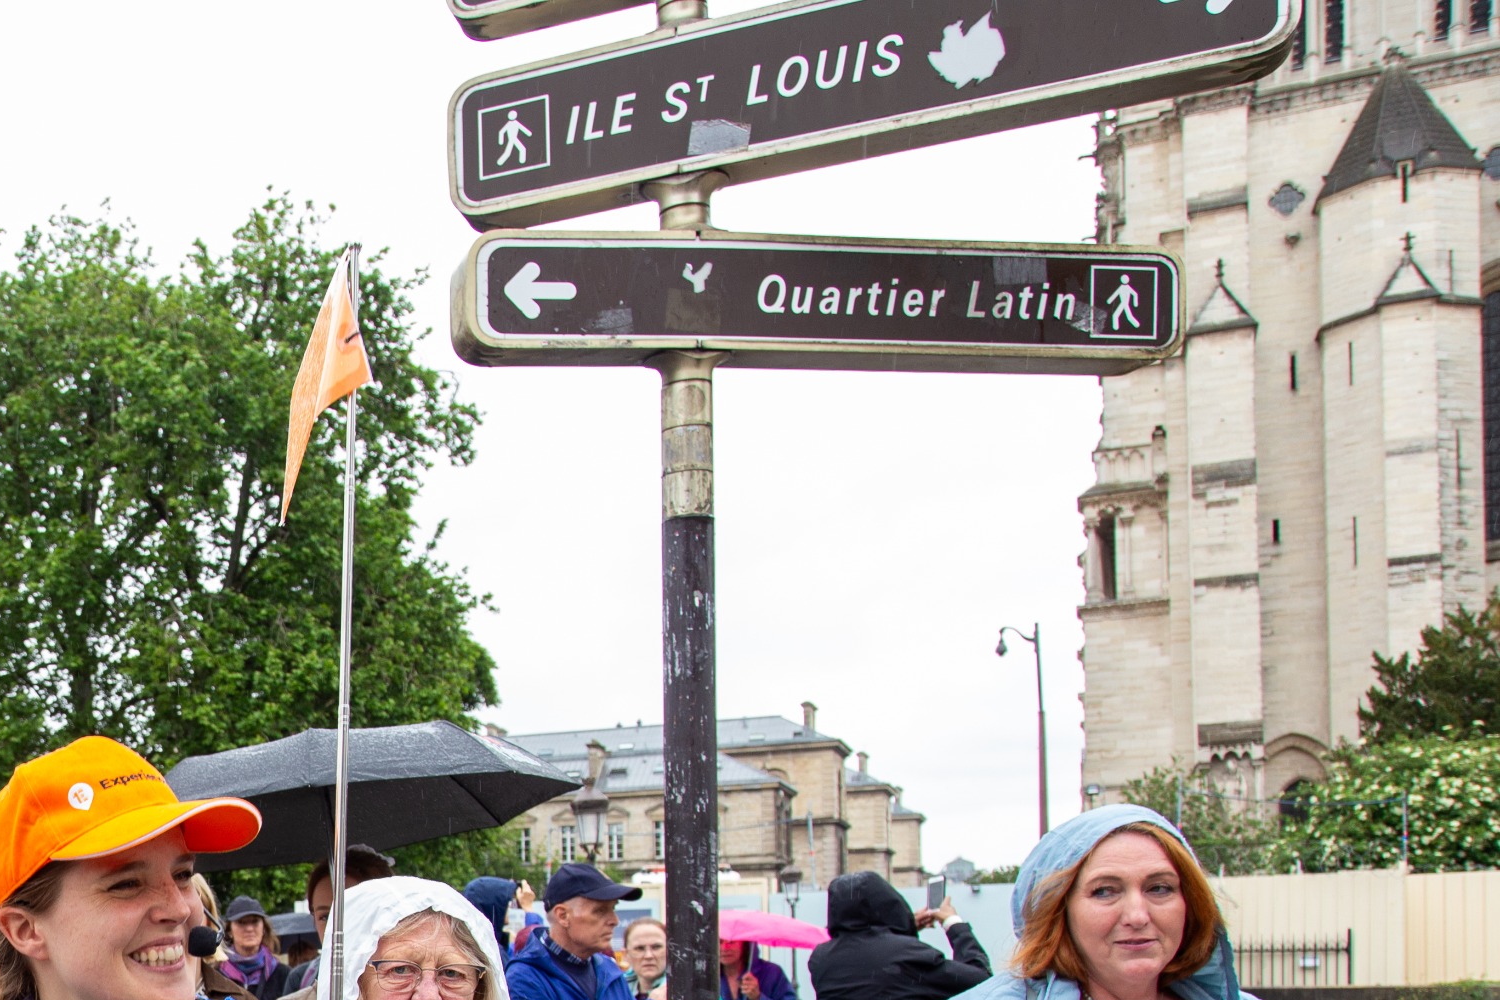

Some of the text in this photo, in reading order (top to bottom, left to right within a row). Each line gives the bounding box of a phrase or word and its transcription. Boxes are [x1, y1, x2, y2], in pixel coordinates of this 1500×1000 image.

[566, 92, 638, 145] ILE
[745, 34, 905, 106] LOUIS
[757, 274, 1076, 320] Quartier Latin
